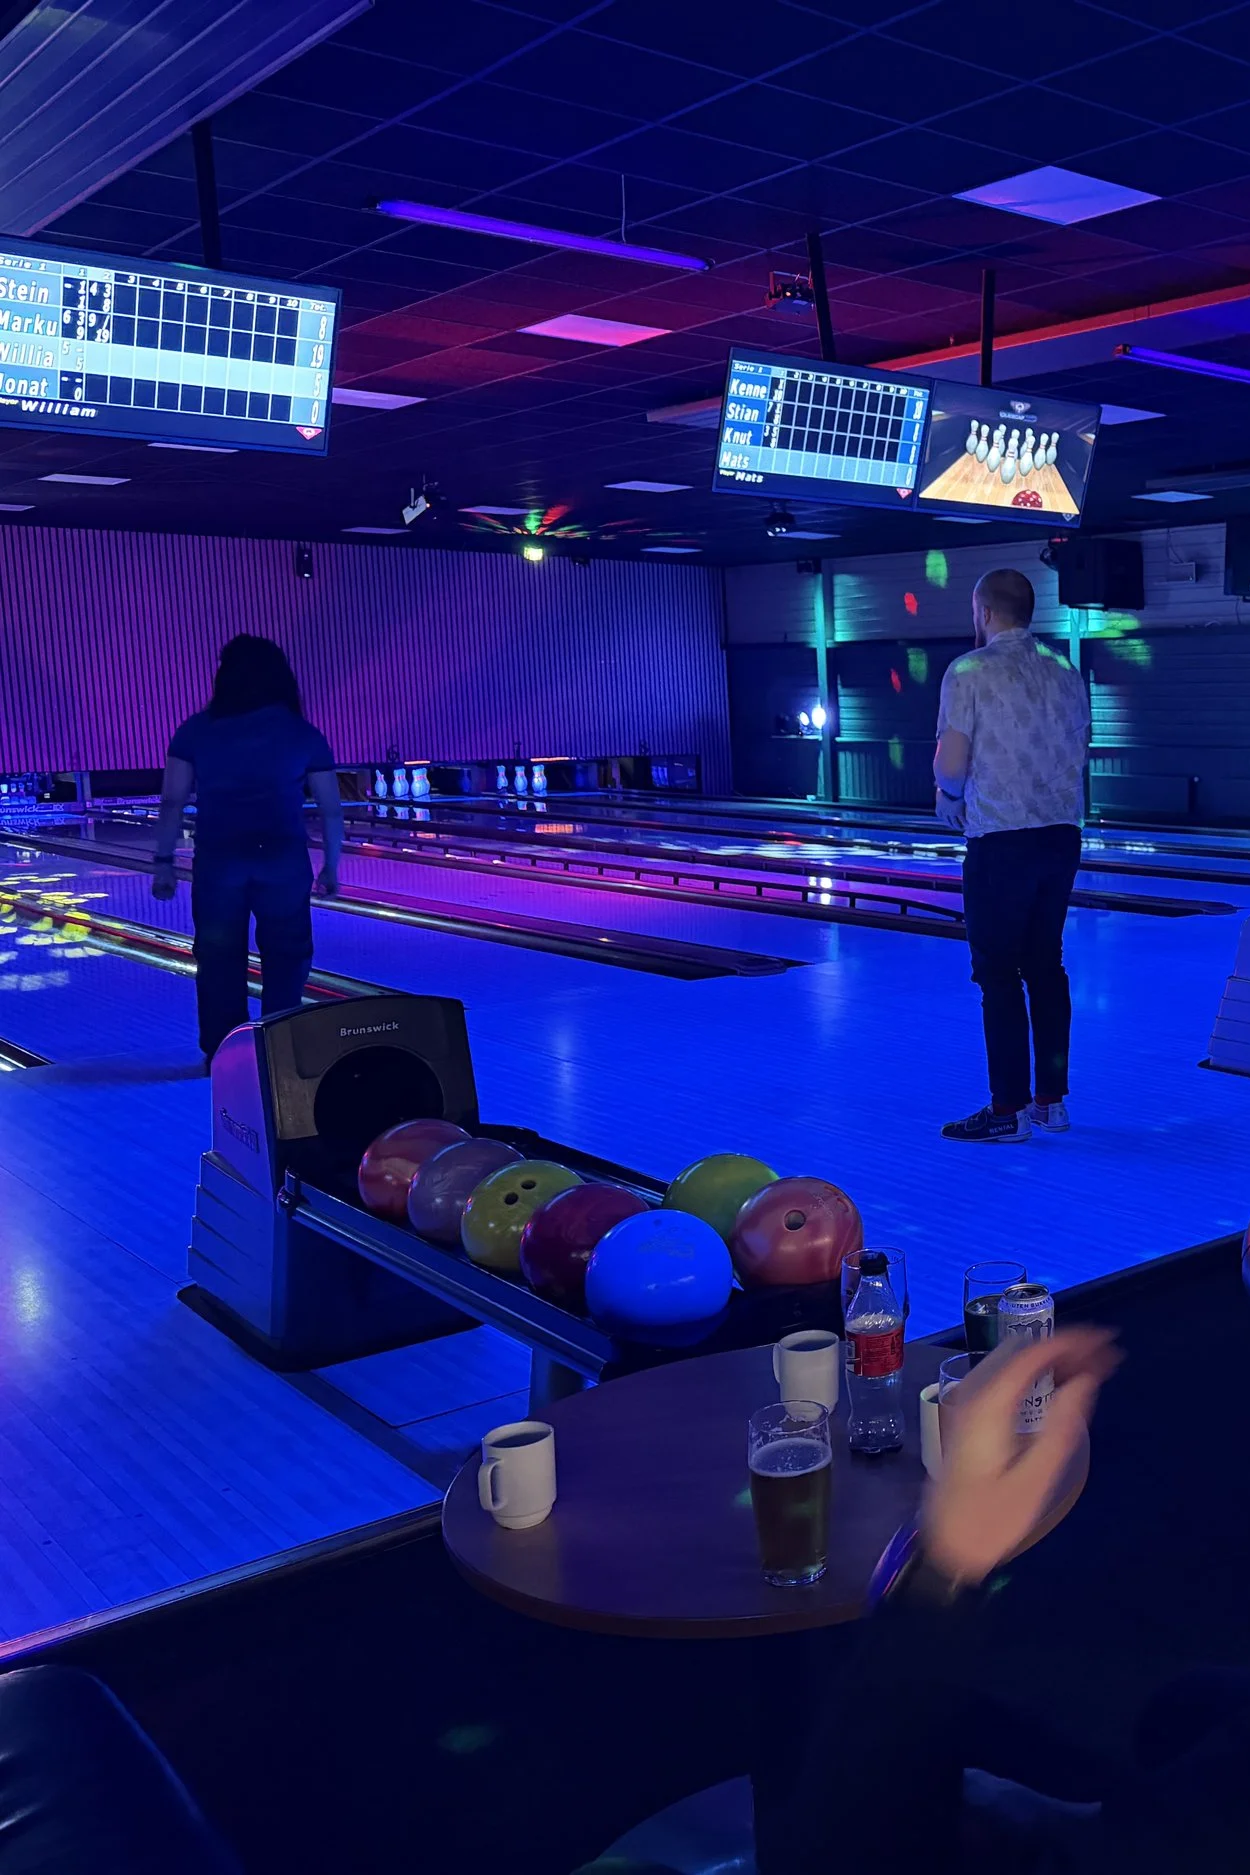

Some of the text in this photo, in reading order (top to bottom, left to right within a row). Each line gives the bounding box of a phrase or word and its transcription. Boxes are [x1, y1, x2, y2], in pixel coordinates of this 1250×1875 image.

[127, 275, 136, 284] 3
[152, 279, 160, 287] 4
[176, 282, 184, 291] 5
[286, 299, 298, 308] 10
[0, 277, 49, 304] Stein
[78, 281, 86, 294] 1
[90, 282, 98, 296] 4
[103, 283, 112, 297] 3
[318, 315, 327, 341] 8
[78, 295, 111, 312] 1 8
[0, 309, 58, 336] Marku
[63, 310, 71, 324] 6
[77, 311, 85, 326] 3
[89, 313, 97, 327] 9
[309, 344, 324, 368] 19
[76, 326, 110, 343] 9 19
[0, 342, 54, 368] Willia
[62, 340, 70, 355] 5
[76, 356, 84, 371] 5
[74, 387, 82, 401] 0
[730, 379, 767, 399] Kenne
[21, 399, 97, 418] William
[310, 400, 319, 424] 0
[726, 402, 759, 422] Stian
[767, 401, 773, 412] 7
[723, 427, 752, 446] Knut
[721, 451, 750, 469] Mats
[735, 471, 764, 484] Mats
[340, 1021, 399, 1037] Brunswick
